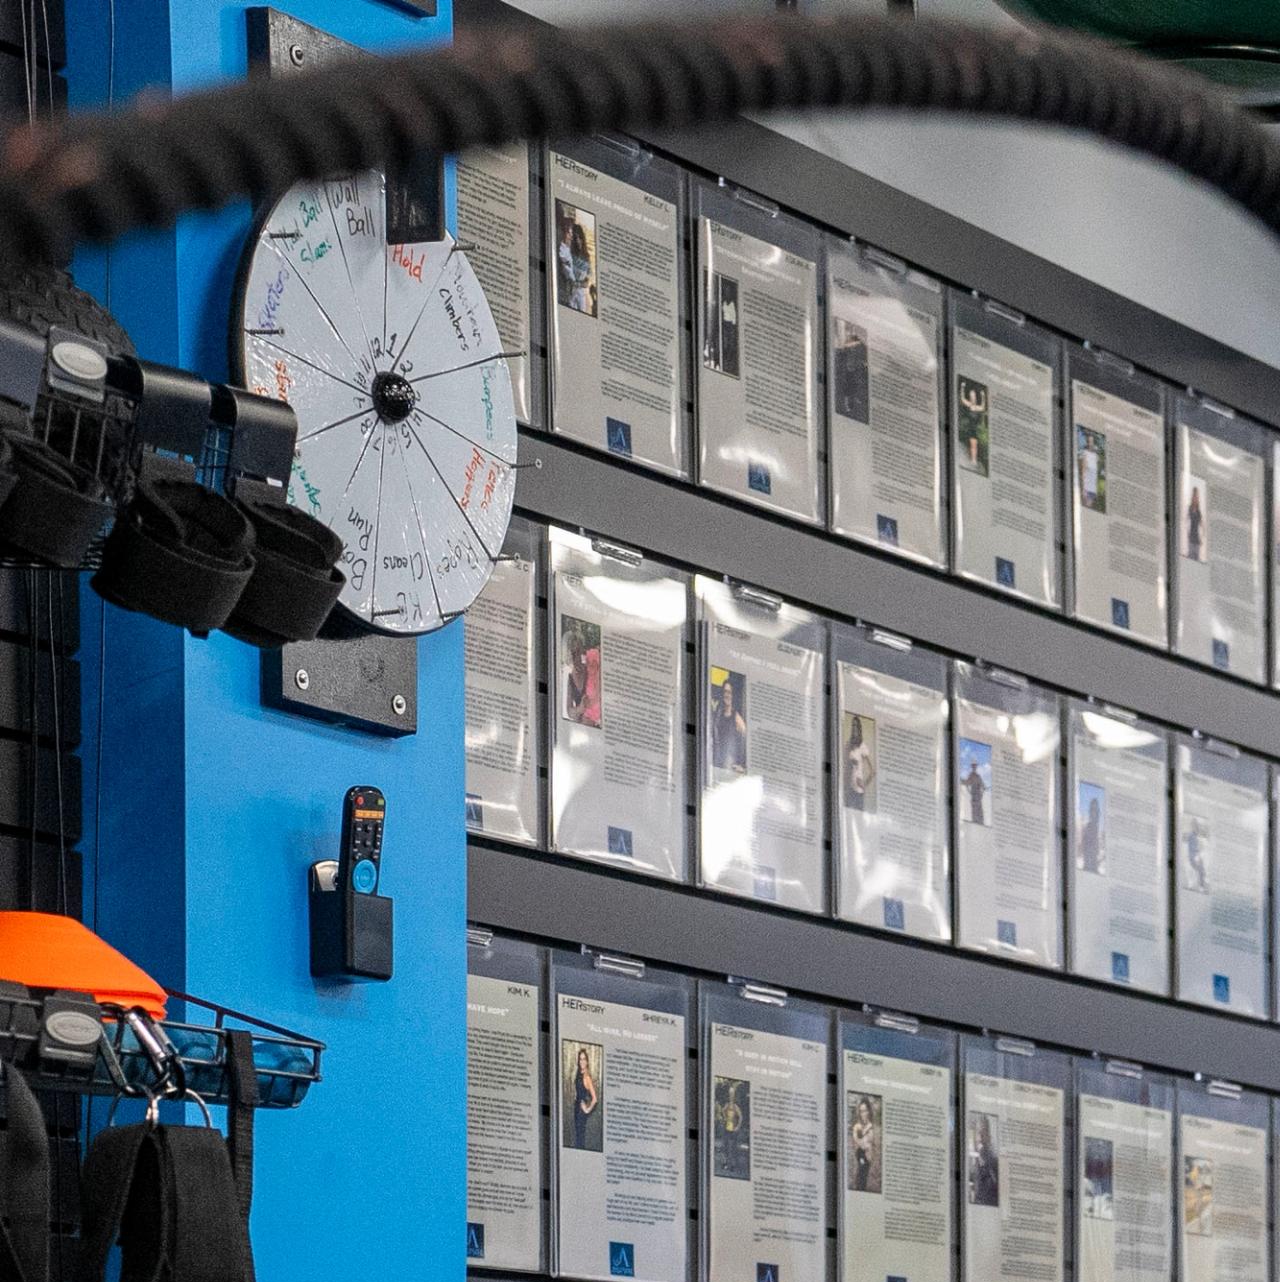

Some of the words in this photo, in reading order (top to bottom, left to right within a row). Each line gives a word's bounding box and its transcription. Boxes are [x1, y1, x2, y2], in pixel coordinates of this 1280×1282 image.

[332, 176, 360, 209] Wall
[346, 206, 375, 237] Ball
[393, 243, 425, 283] Hold
[439, 287, 469, 351] Climbers
[401, 423, 412, 449] 5
[347, 506, 373, 551] Run
[383, 551, 424, 582] Cleans
[437, 530, 479, 580] Ropes
[562, 997, 606, 1015] HERSTORY
